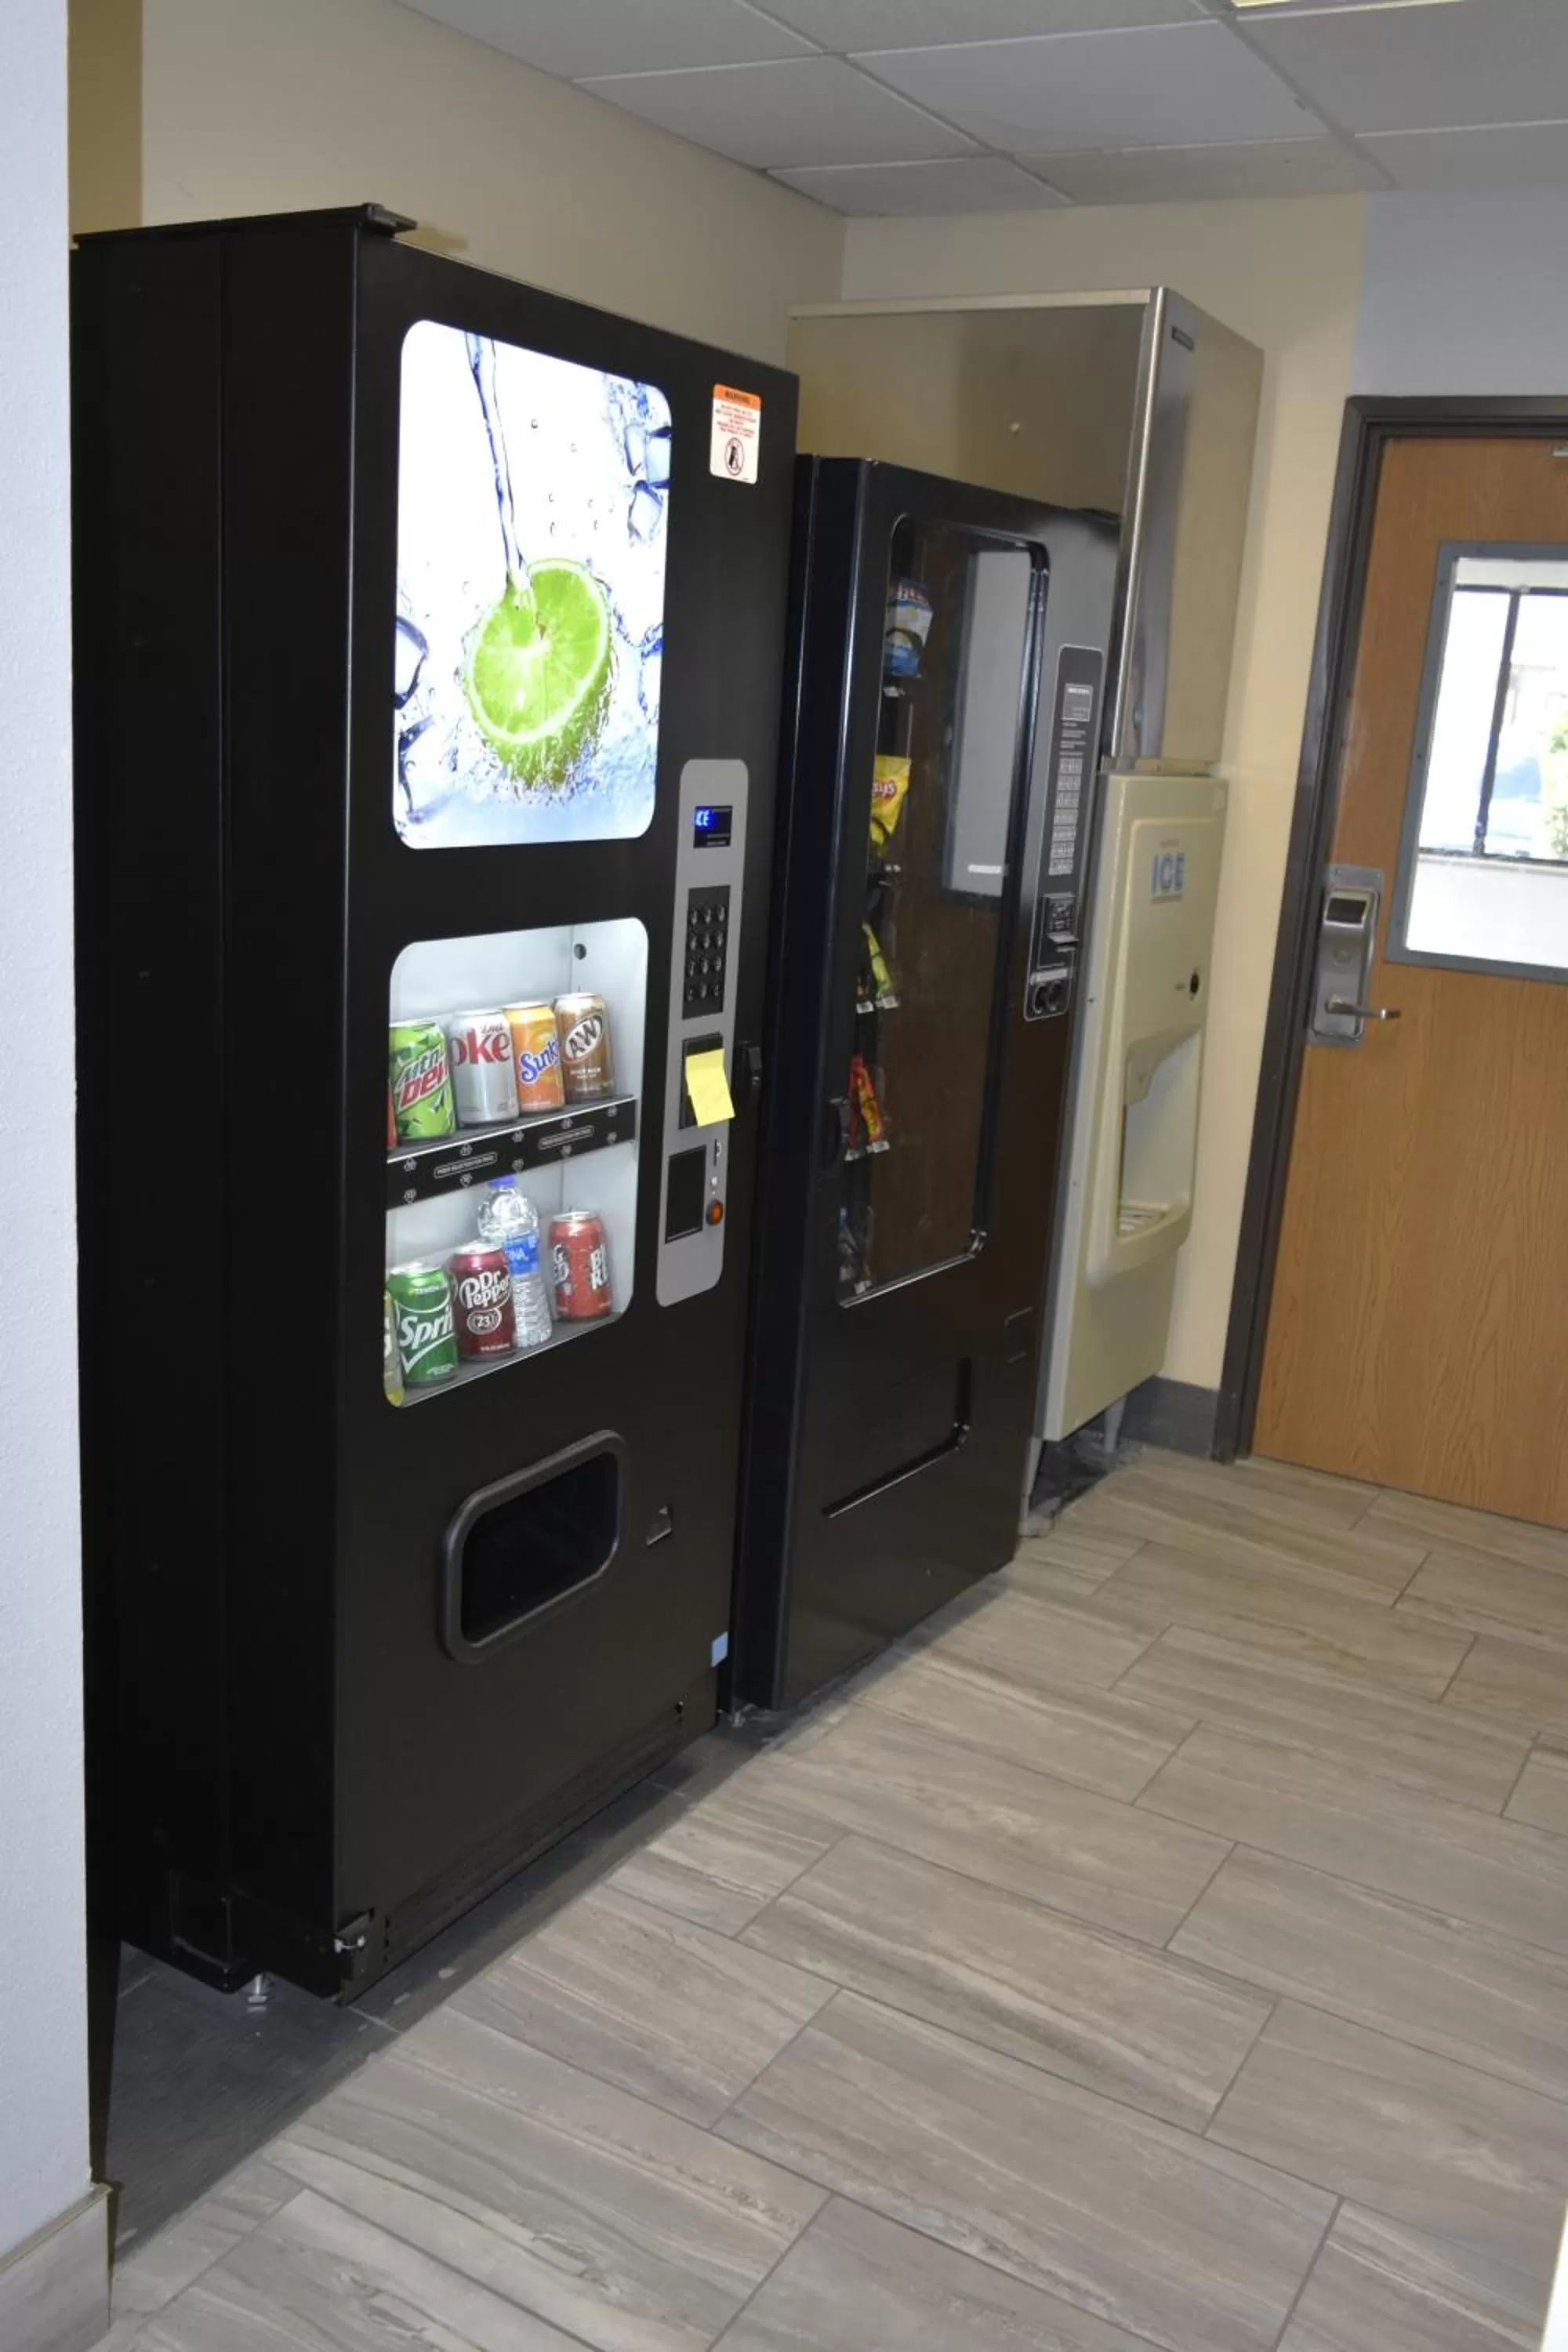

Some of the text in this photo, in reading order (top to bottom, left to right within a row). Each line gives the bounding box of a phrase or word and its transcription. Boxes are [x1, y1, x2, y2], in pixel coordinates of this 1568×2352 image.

[1151, 852, 1185, 893] ICE
[463, 1274, 510, 1308] Pepper
[479, 1271, 501, 1289] Dr
[475, 1316, 490, 1328] 23
